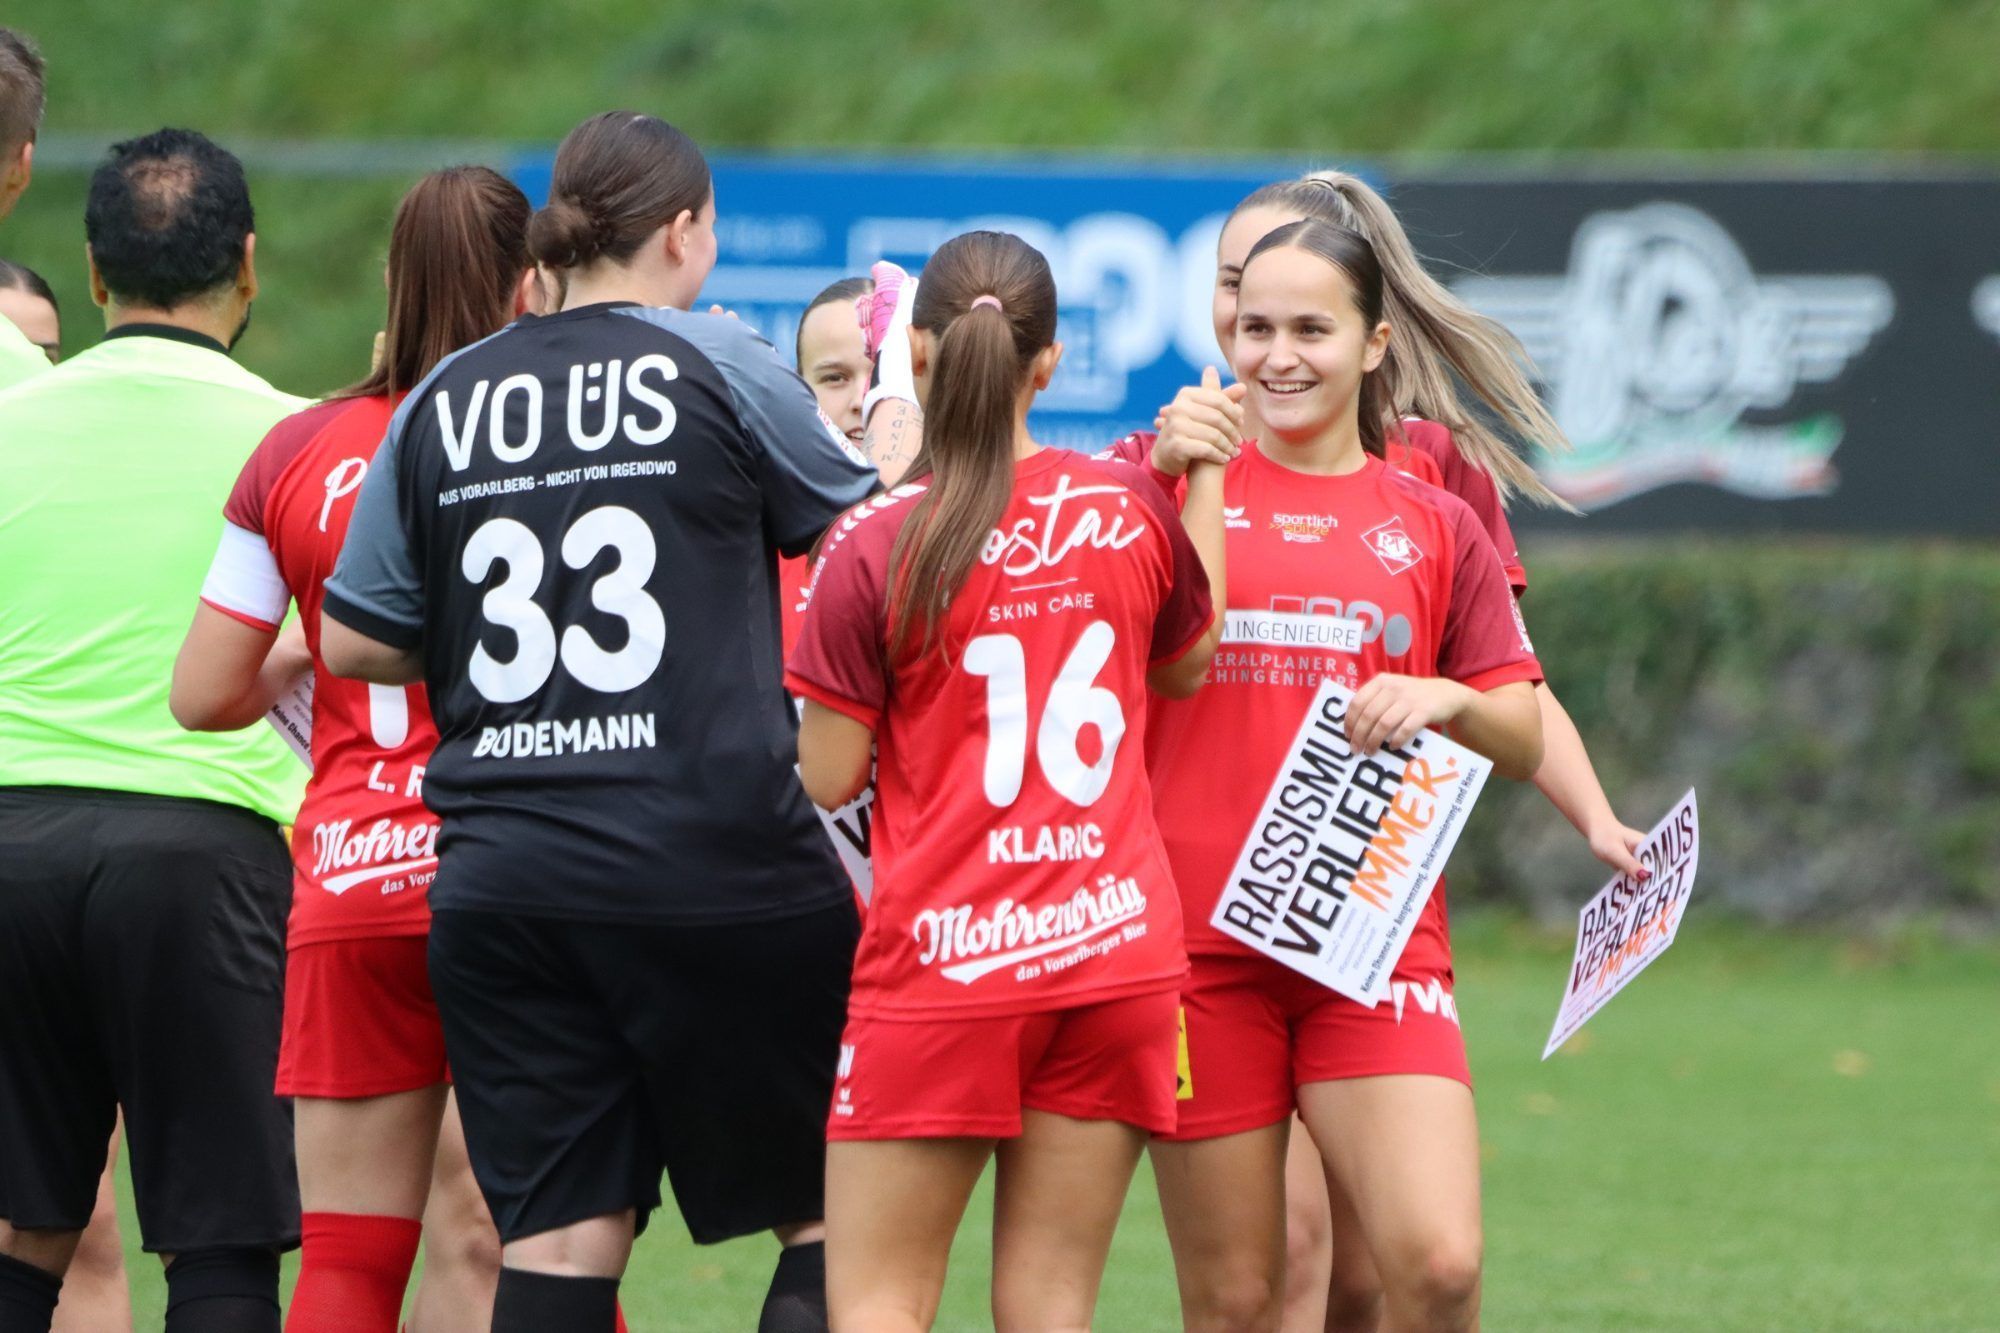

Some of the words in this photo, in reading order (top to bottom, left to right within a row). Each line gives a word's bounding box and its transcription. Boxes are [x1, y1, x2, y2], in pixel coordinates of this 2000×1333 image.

[435, 373, 544, 472] VO
[438, 491, 460, 507] AUS
[460, 476, 535, 501] VORARLBERG
[546, 469, 581, 488] NICHT
[583, 464, 609, 481] VON
[610, 460, 677, 478] IRGENDWO
[980, 474, 1146, 576] ostai
[461, 505, 666, 703] 33
[988, 602, 1038, 623] SKIN
[1049, 593, 1095, 613] CARE
[1236, 620, 1357, 648] INGENIEURE
[1215, 652, 1337, 672] ERALPLANER
[472, 713, 656, 758] BODEMANN
[962, 620, 1126, 807] 16
[988, 822, 1106, 865] KLARIC
[381, 879, 405, 895] das
[913, 874, 1148, 966] Mohrenbräu
[1015, 965, 1042, 982] das
[1043, 933, 1121, 973] Vorarlberger
[1121, 923, 1148, 942] Bier
